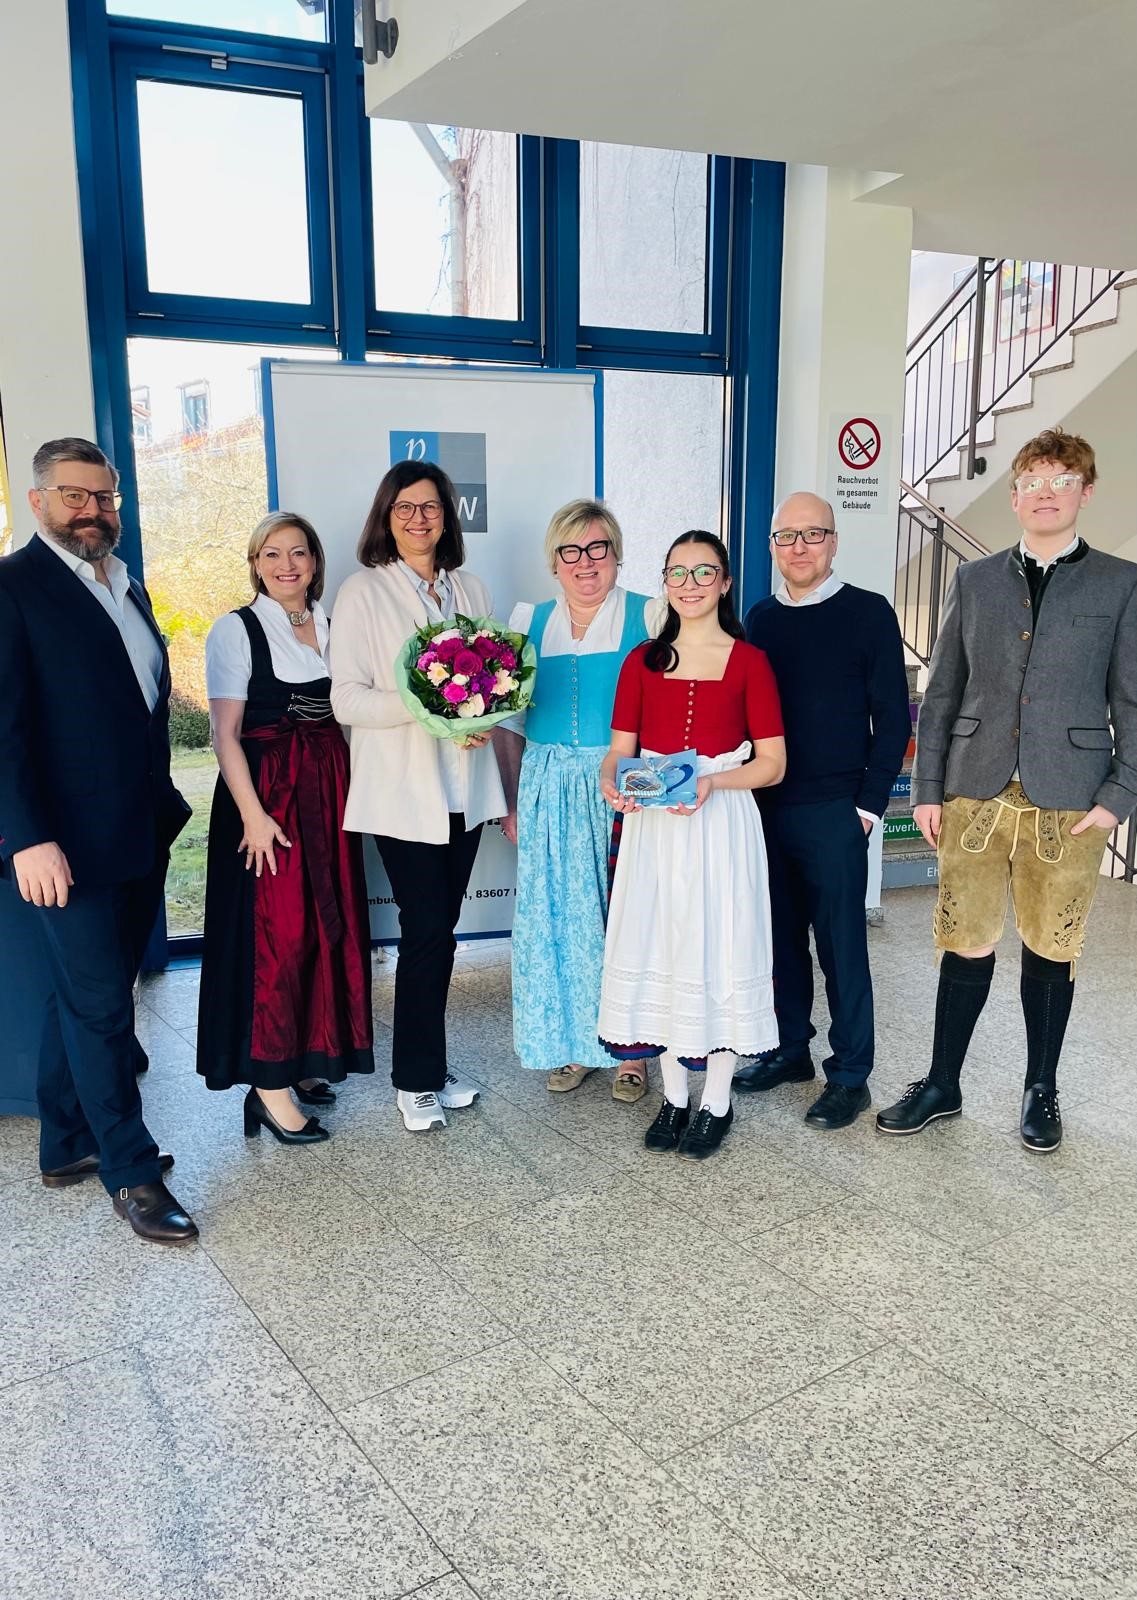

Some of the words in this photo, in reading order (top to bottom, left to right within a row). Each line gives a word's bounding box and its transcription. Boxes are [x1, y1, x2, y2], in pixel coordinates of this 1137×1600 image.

[837, 475, 879, 485] Rauchverbot
[836, 488, 846, 496] im
[846, 490, 878, 498] gesamten
[842, 500, 872, 510] Gebäude
[475, 888, 510, 899] 83607
